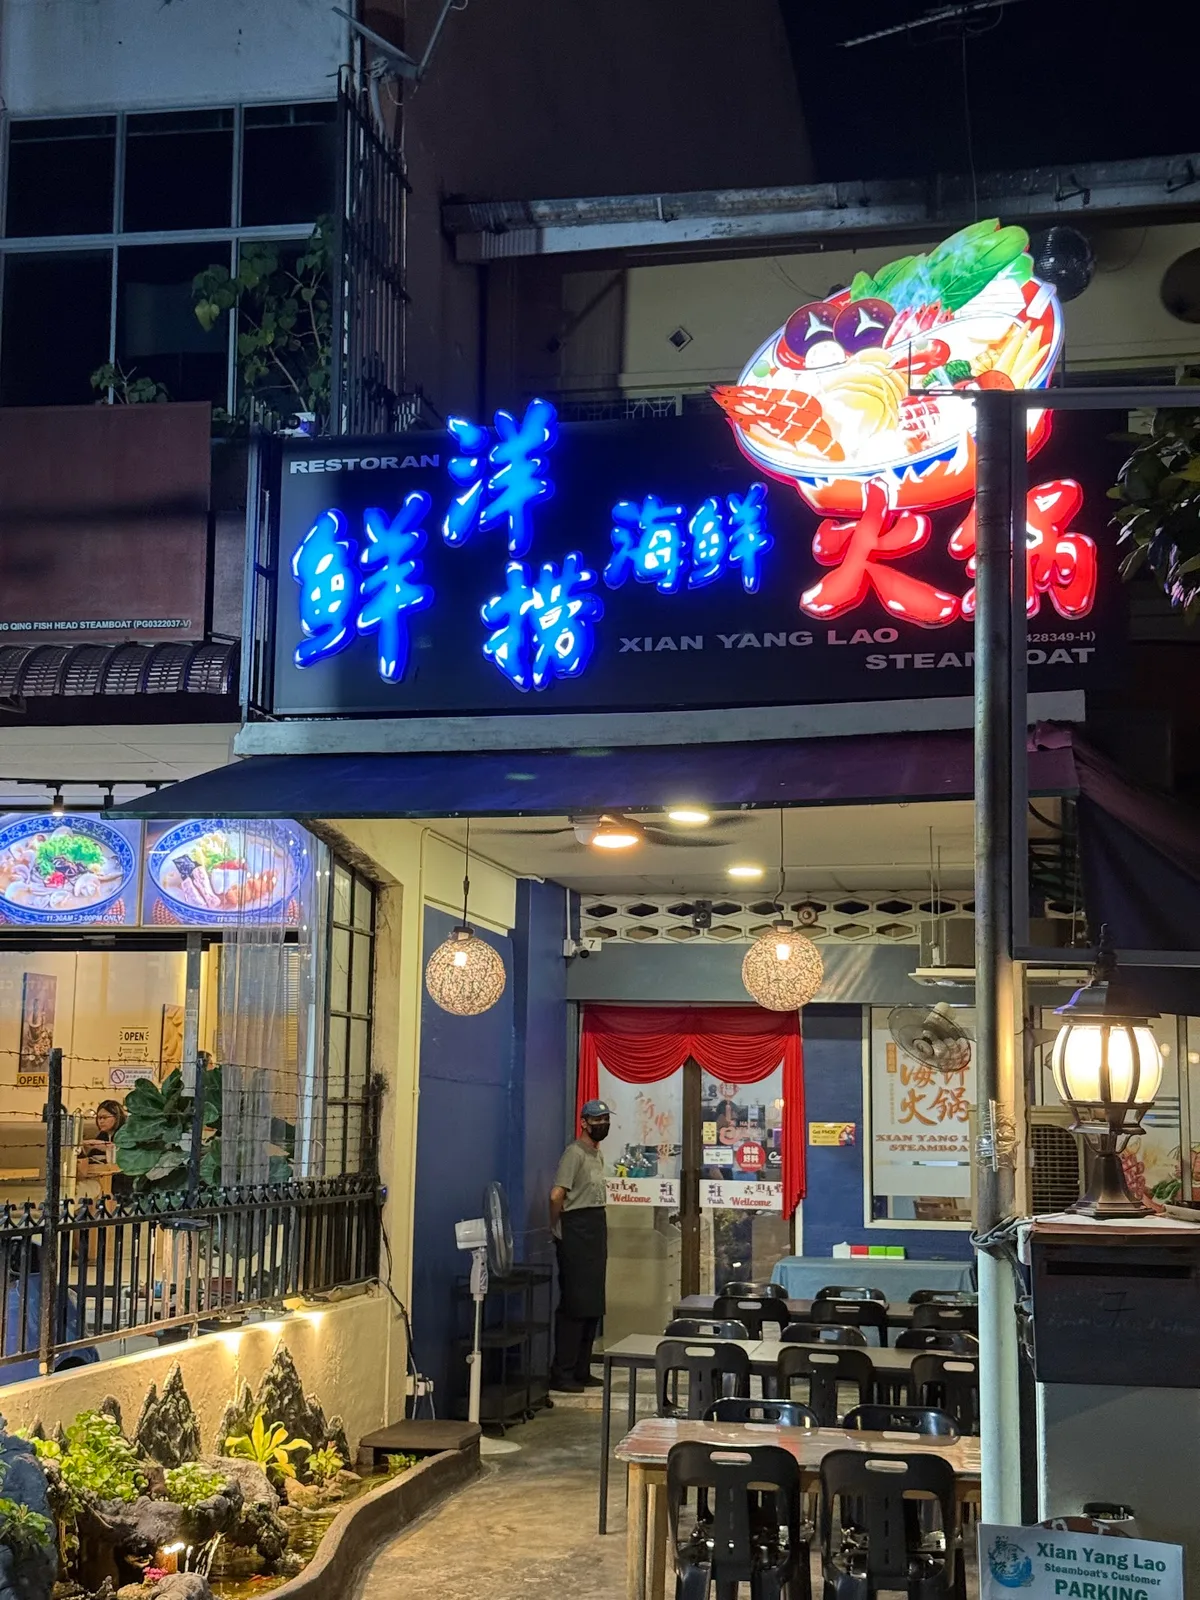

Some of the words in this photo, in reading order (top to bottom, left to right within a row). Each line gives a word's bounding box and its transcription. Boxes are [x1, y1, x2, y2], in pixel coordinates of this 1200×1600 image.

[290, 453, 440, 474] RESTORAN
[602, 481, 776, 595] 海鲜
[10, 621, 32, 631] QING
[33, 621, 53, 630] FISH
[54, 621, 78, 630] HEAD
[80, 620, 132, 629] STEAMBOAT
[619, 634, 703, 653] XIAN
[716, 630, 814, 650] YANG
[827, 627, 899, 646] LAO
[865, 647, 1096, 670] STEAOAT
[589, 940, 595, 949] 7
[124, 1032, 145, 1041] OPEN
[19, 1075, 45, 1085] OPEN
[875, 1134, 913, 1142] XIAN
[916, 1134, 958, 1142] YANG
[889, 1144, 969, 1152] STEAMBOA
[1036, 1541, 1078, 1561] Xian
[1082, 1547, 1129, 1571] Yang
[1133, 1553, 1166, 1572] Lao
[1044, 1562, 1108, 1579] Steamboat's
[1110, 1571, 1161, 1586] Customer
[1055, 1578, 1149, 1600] PARKING
